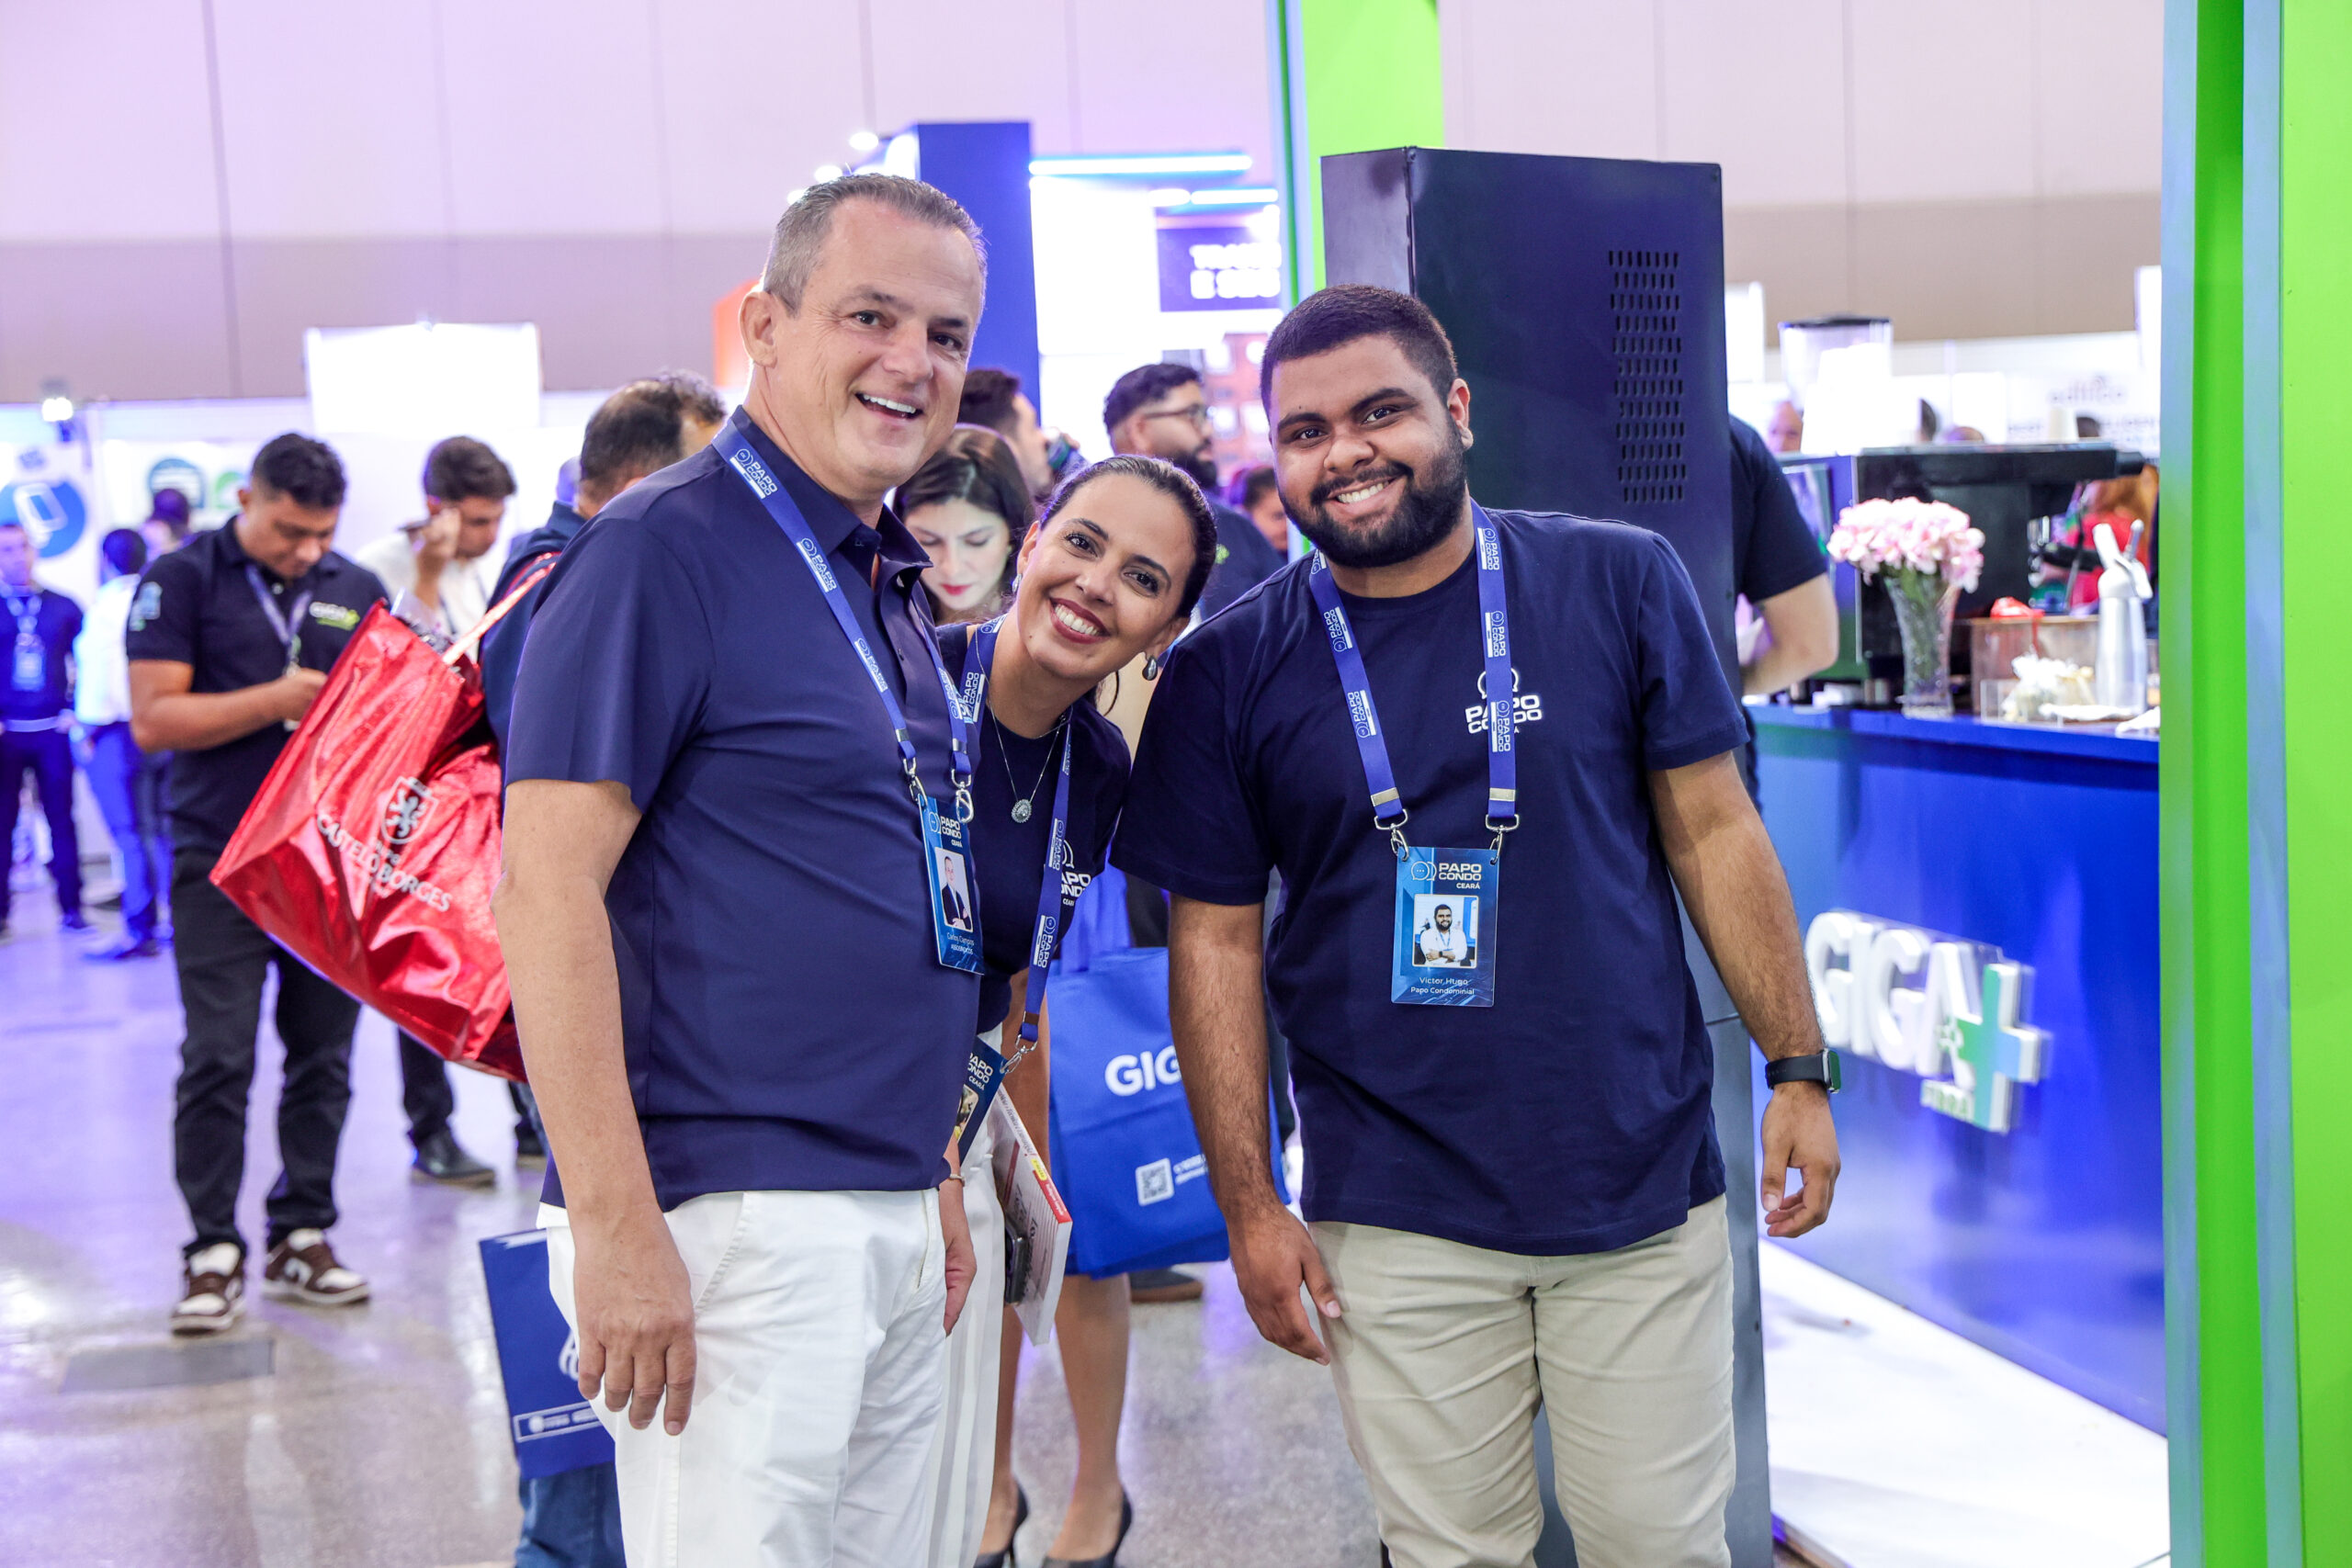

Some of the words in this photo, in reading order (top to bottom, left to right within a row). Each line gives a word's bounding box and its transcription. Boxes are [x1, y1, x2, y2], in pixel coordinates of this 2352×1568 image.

[748, 467, 772, 496] CONDO
[752, 460, 778, 493] PAPO
[1485, 542, 1494, 570] CONDO
[1490, 542, 1500, 570] PAPO
[815, 554, 837, 589] PAPO
[1323, 611, 1338, 638] PAPO
[1329, 609, 1342, 637] CONDO
[1498, 626, 1507, 657] PAPO
[963, 671, 974, 703] PAPO
[969, 672, 979, 705] CONDO
[1347, 692, 1359, 722] PAPO
[1354, 691, 1366, 721] CONDO
[1464, 694, 1541, 724] PO
[1467, 708, 1543, 735] CDO
[1502, 717, 1511, 752] PAPO
[940, 816, 961, 831] PAPO
[941, 826, 962, 840] CONDO
[317, 814, 379, 873] CASTELO
[1061, 871, 1091, 887] APO
[1438, 863, 1482, 874] PAPO
[1438, 872, 1482, 882] CONDO
[380, 863, 453, 913] BORGES
[1455, 882, 1481, 890] CEARÁ
[1037, 933, 1046, 967] CONDO
[1041, 933, 1053, 968] PAPO
[1410, 986, 1430, 995] Papo
[1430, 987, 1475, 995] Condominial
[1419, 976, 1443, 985] Victor
[1445, 977, 1469, 987] Hugo
[967, 1062, 990, 1084] ONDO
[1104, 1044, 1183, 1097] GIG
